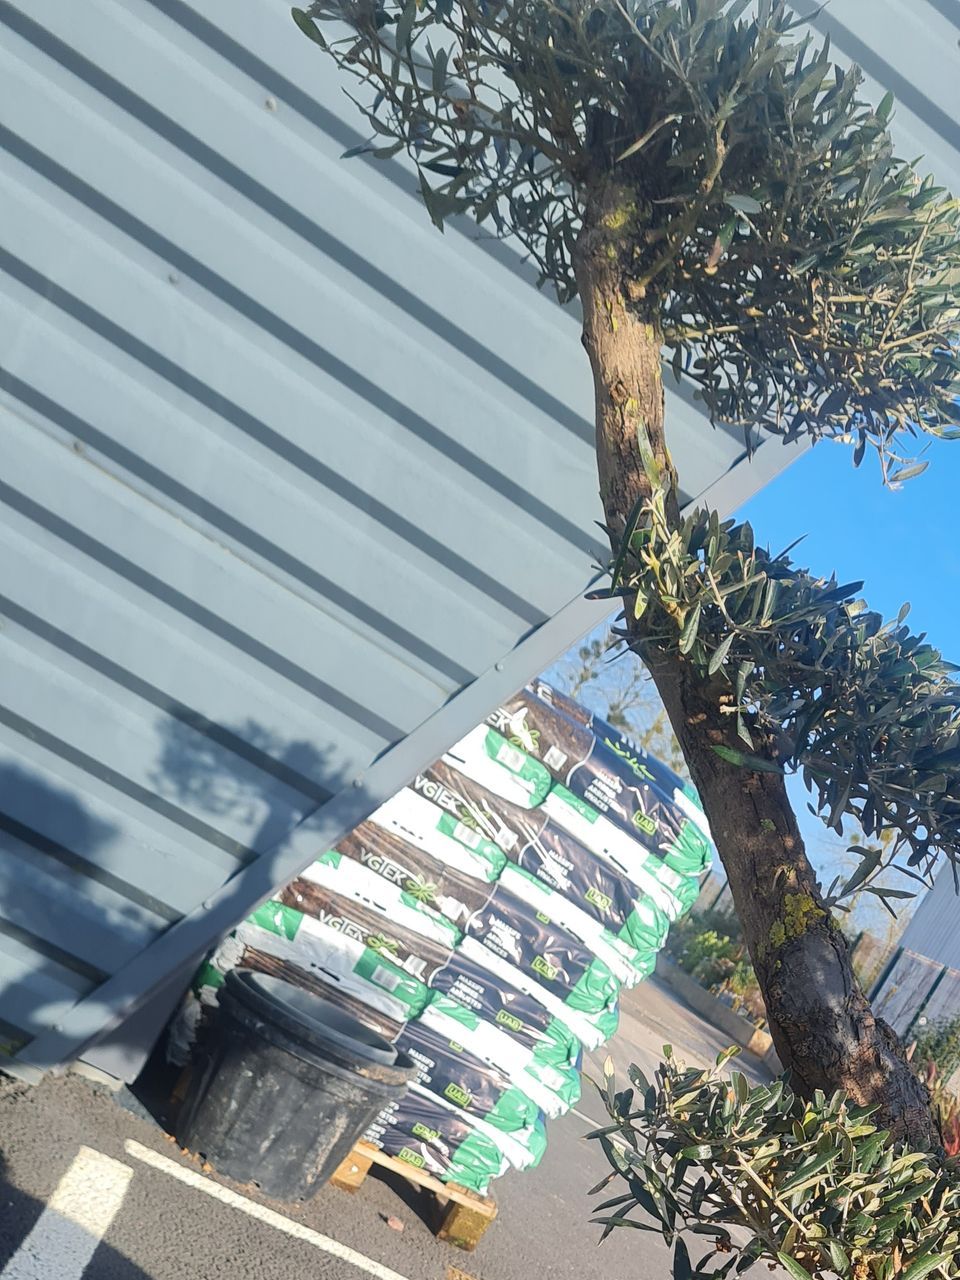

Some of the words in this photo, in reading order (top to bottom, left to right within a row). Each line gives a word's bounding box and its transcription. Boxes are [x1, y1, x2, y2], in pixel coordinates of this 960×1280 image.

[634, 813, 654, 830] UAB
[360, 846, 409, 886] VGTEK
[587, 889, 608, 907] UAB
[318, 908, 372, 942] VGTEK
[534, 958, 555, 978] UAB
[498, 1012, 520, 1029] UAB
[448, 1086, 471, 1105] UAB
